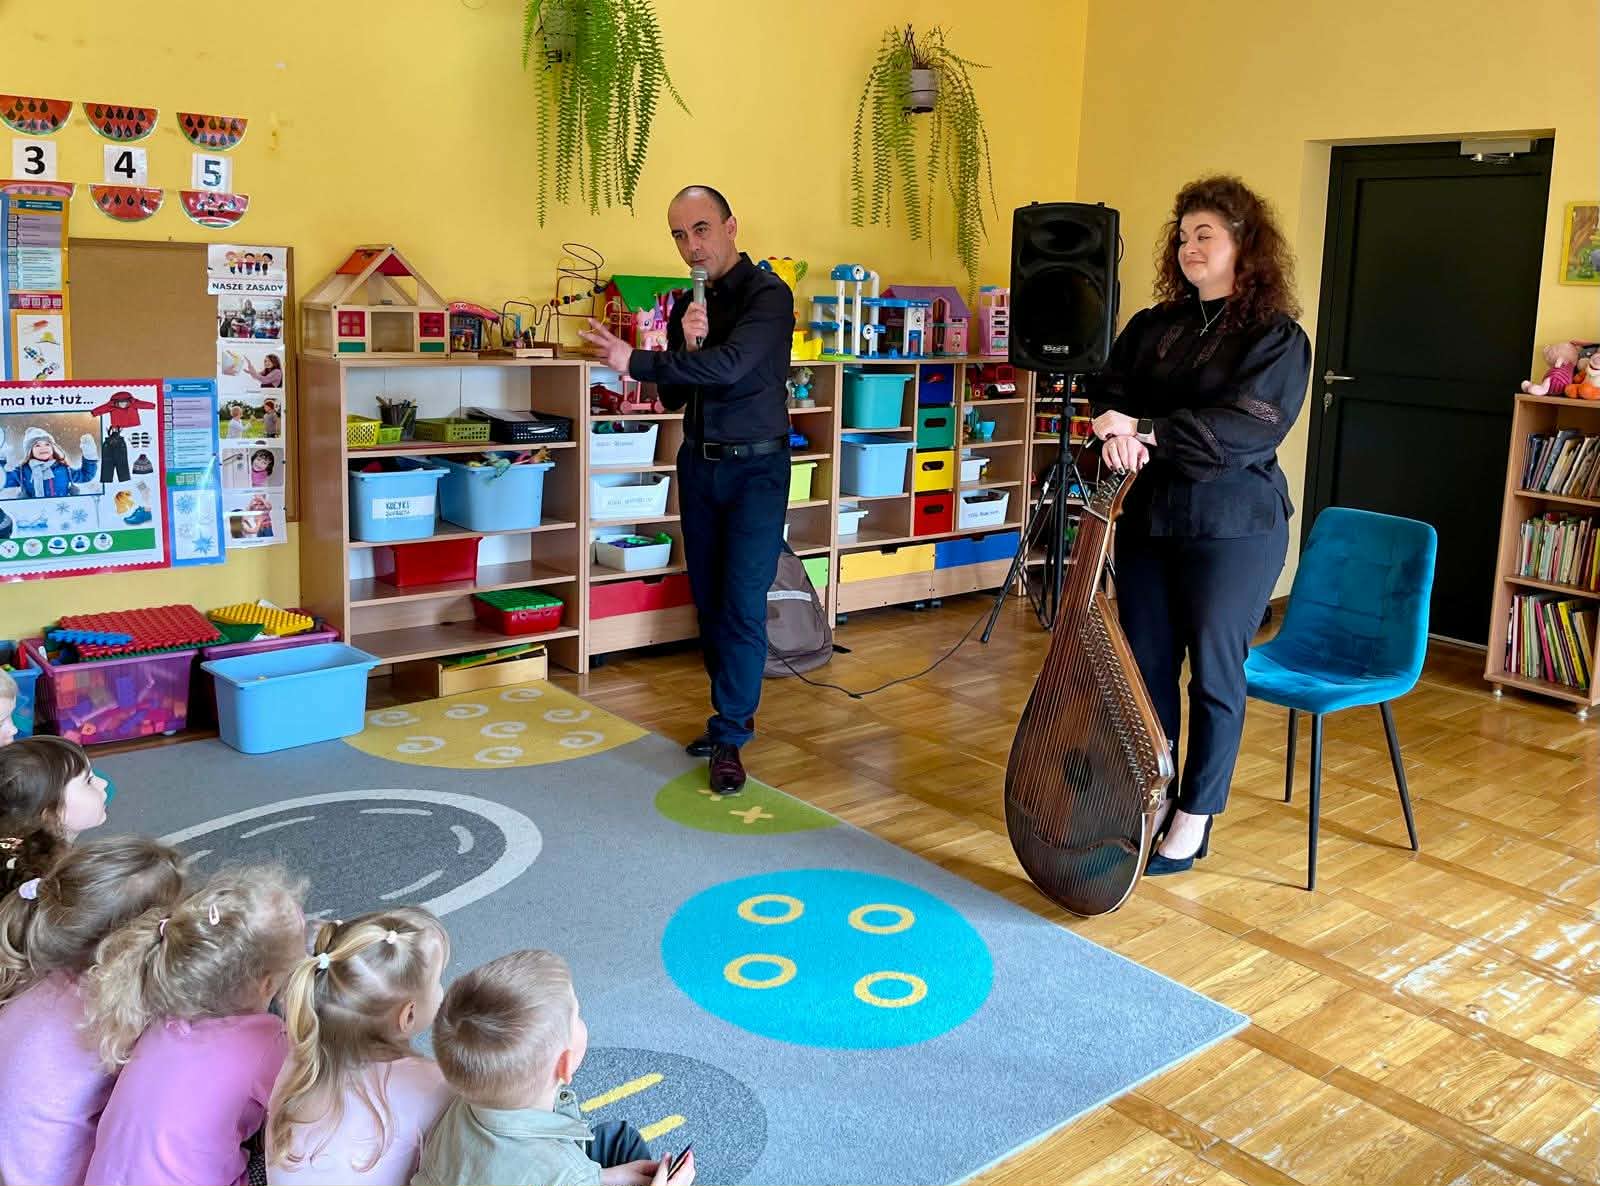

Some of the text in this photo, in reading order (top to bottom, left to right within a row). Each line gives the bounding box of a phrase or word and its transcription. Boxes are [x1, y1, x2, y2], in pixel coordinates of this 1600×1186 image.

[24, 146, 46, 175] 3
[114, 151, 136, 179] 4
[203, 160, 222, 187] 5
[212, 282, 284, 292] NASZE ZASADY
